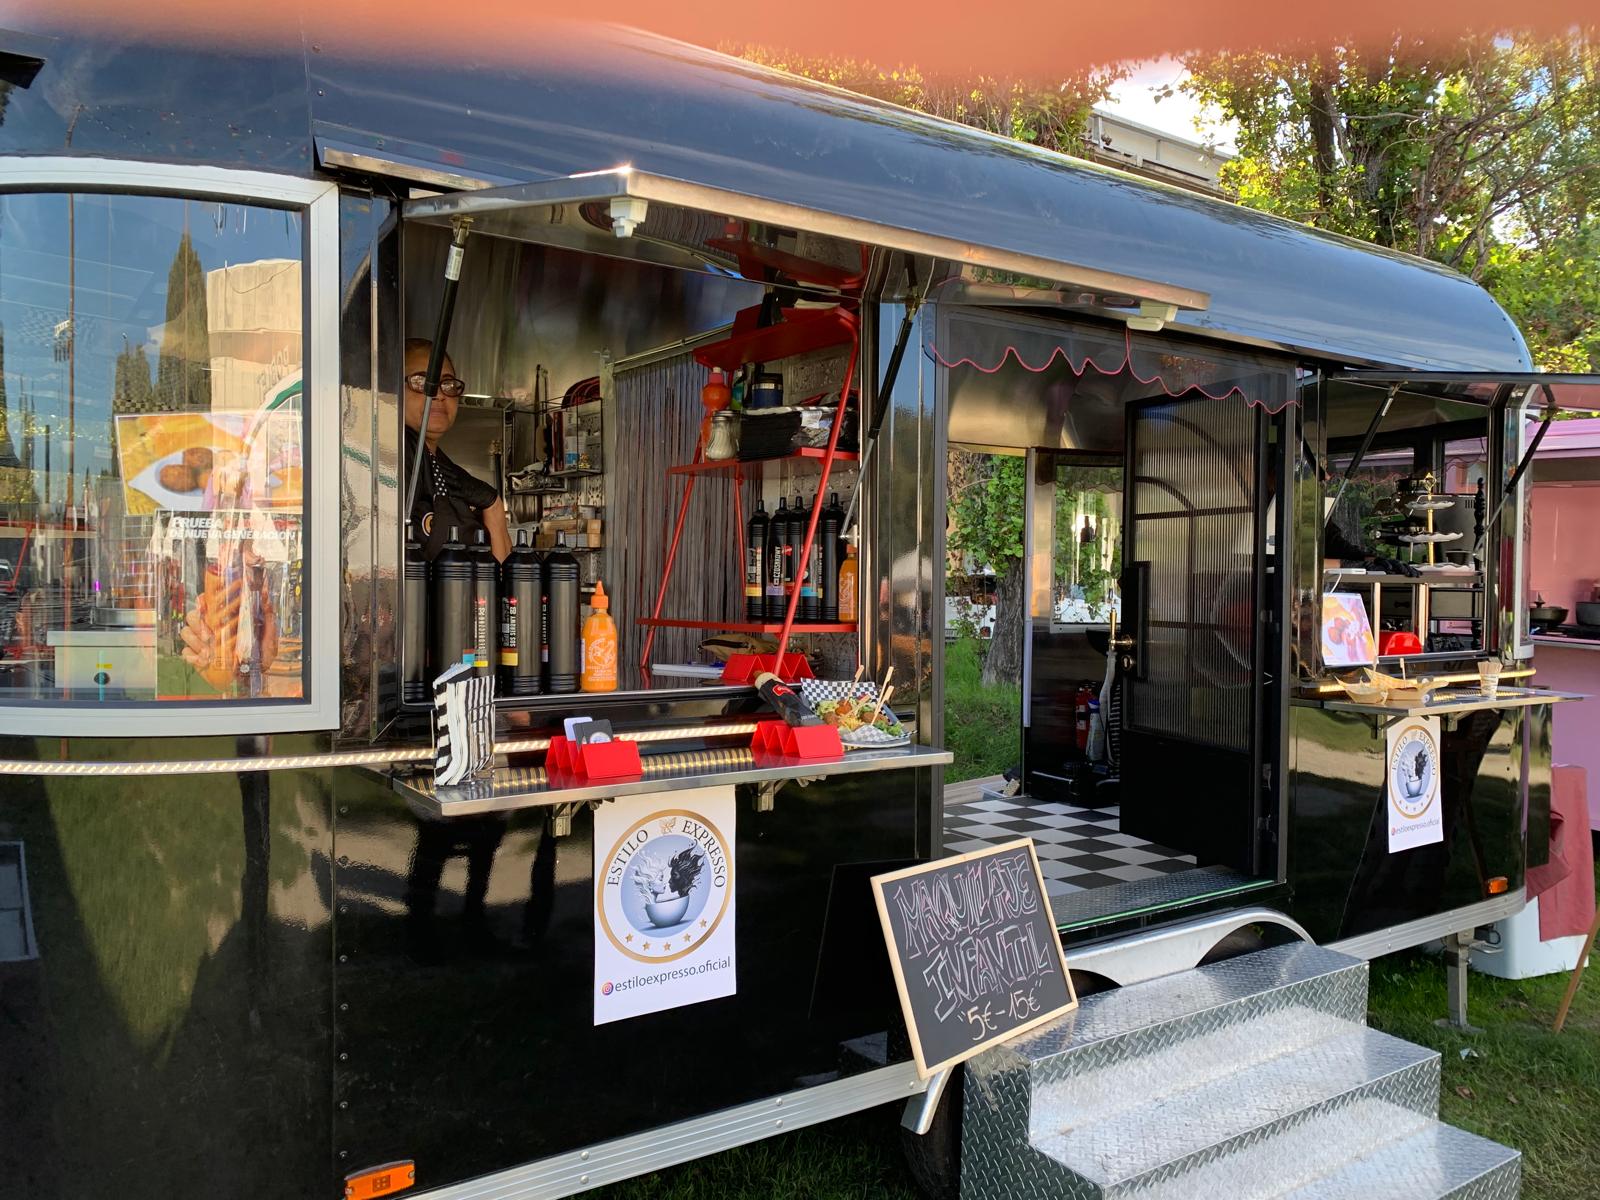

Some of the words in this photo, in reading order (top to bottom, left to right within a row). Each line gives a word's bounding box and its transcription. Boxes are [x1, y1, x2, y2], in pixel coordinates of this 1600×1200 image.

[608, 830, 648, 886] ESTILO
[682, 820, 726, 887] EXPRESSO
[615, 956, 731, 992] estiloexpresso.oficial
[923, 923, 1055, 1023] INFANTIL
